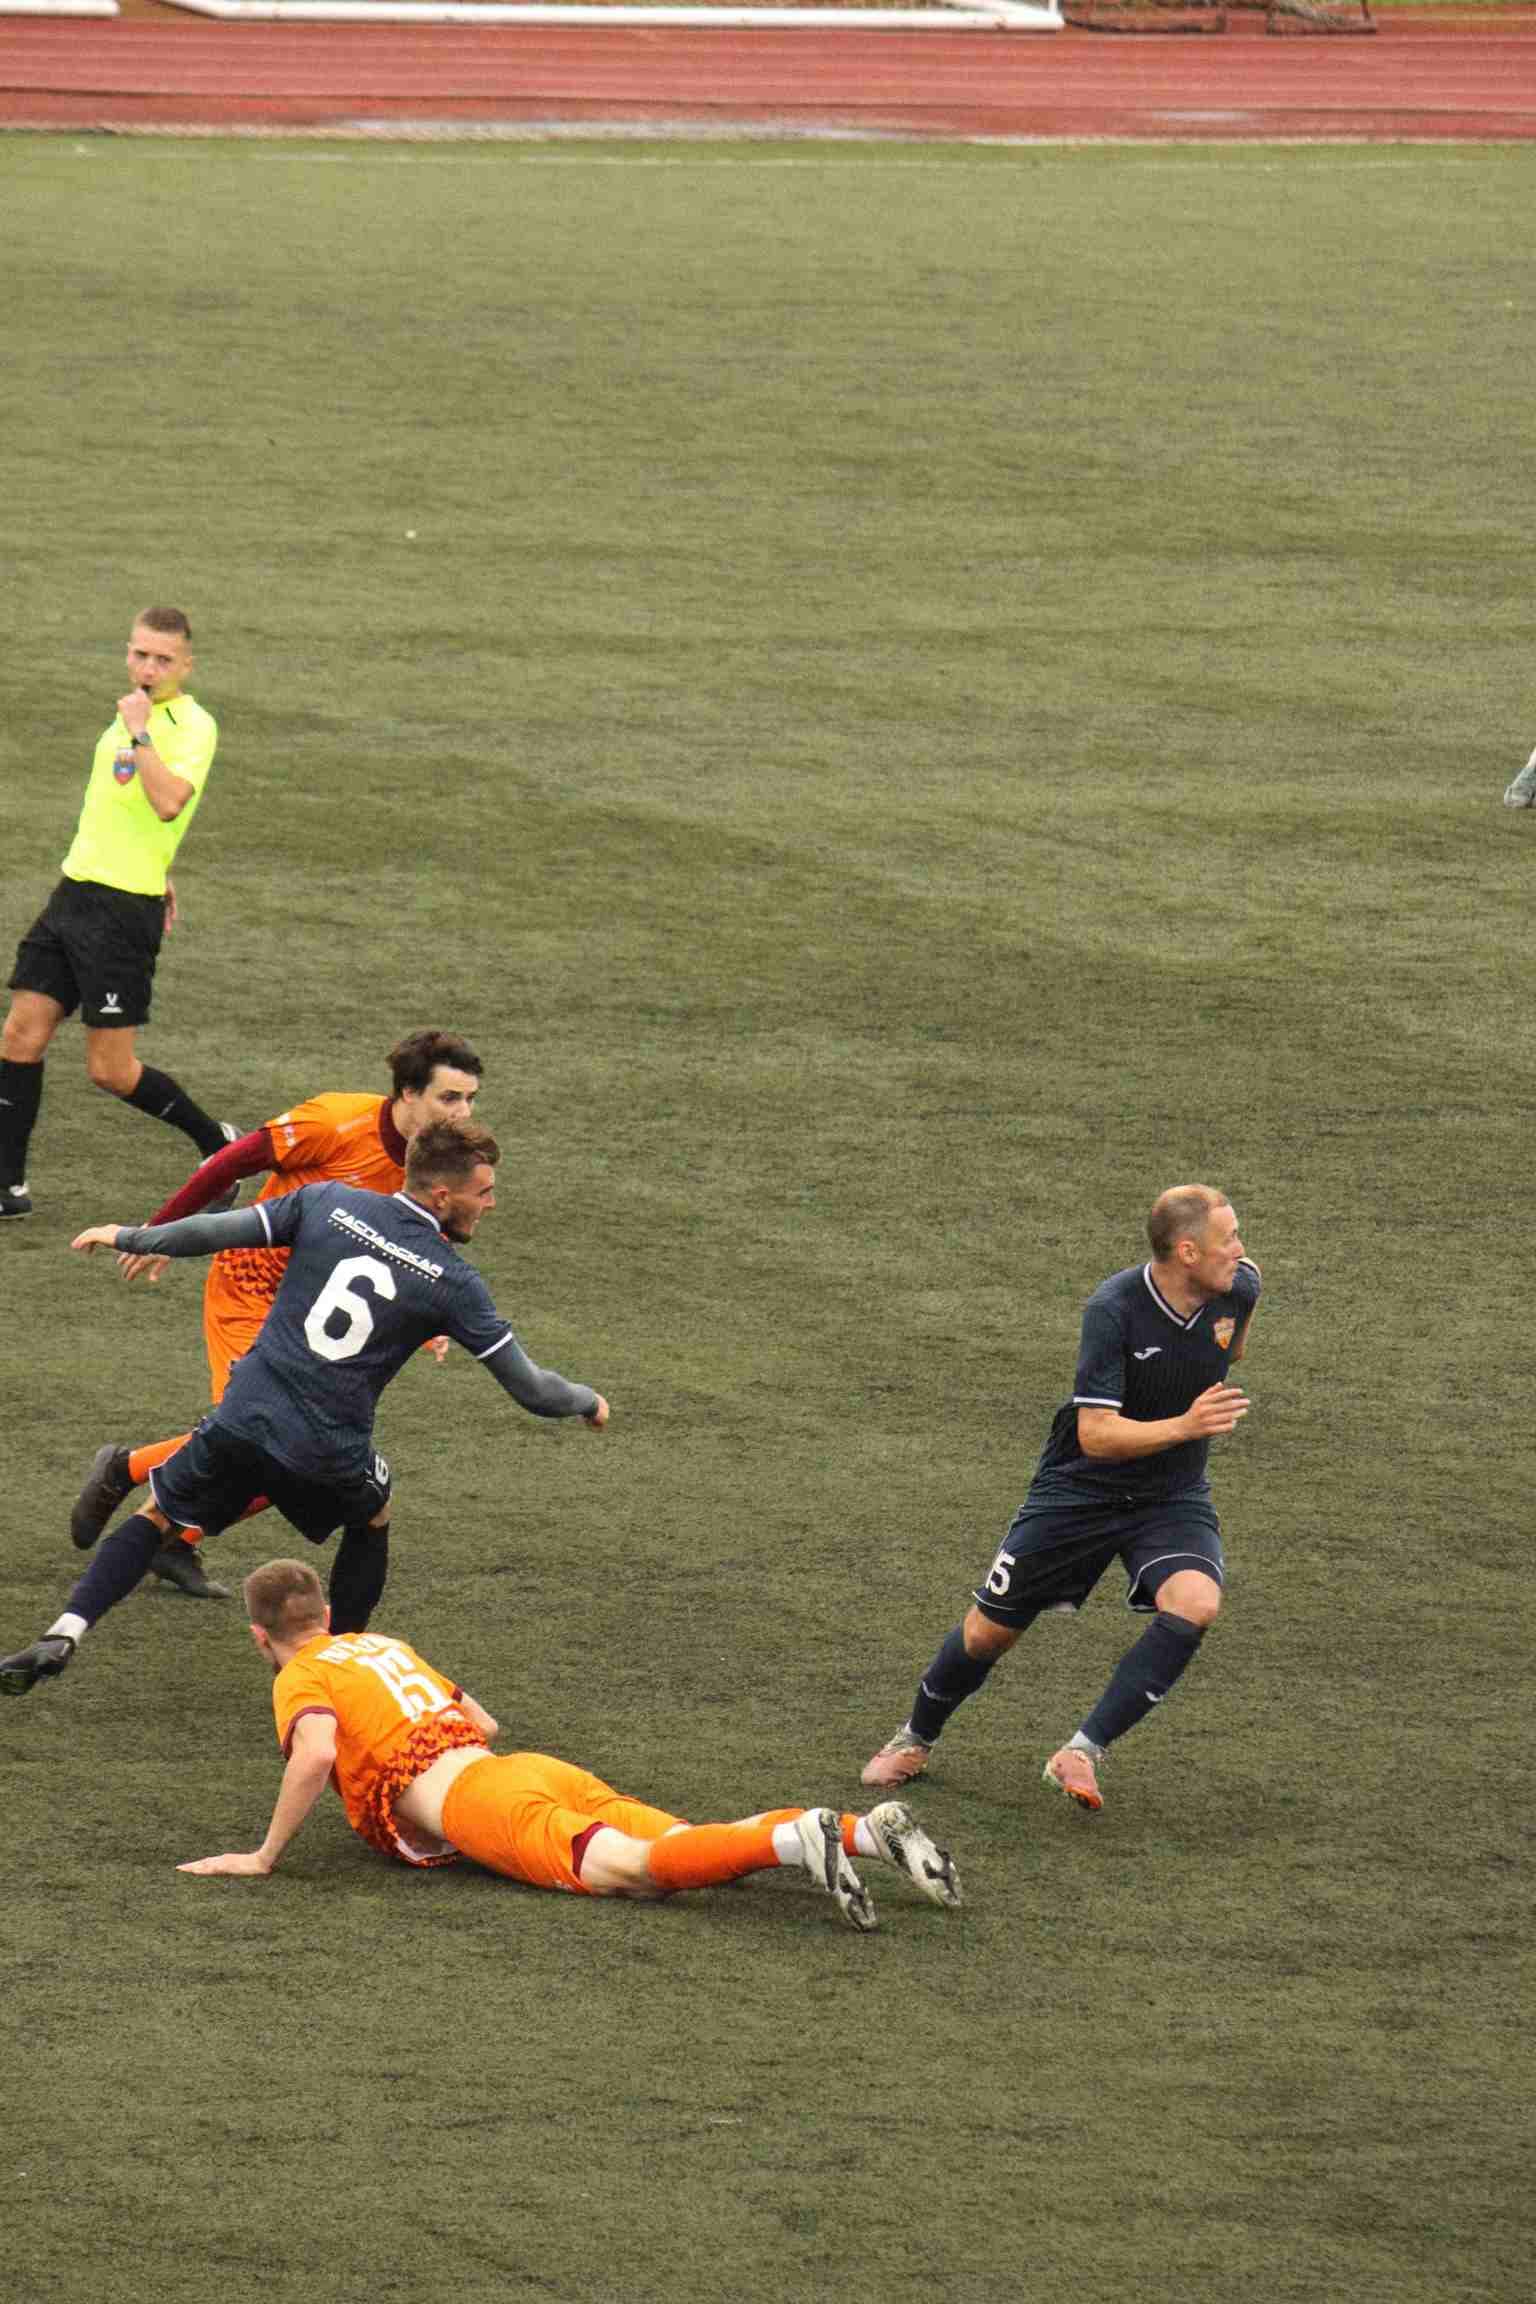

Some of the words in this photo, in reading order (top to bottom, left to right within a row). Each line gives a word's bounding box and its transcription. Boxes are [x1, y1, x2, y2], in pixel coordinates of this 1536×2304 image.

[304, 1255, 397, 1361] 6
[375, 1454, 389, 1486] 6
[354, 1648, 453, 1723] 15
